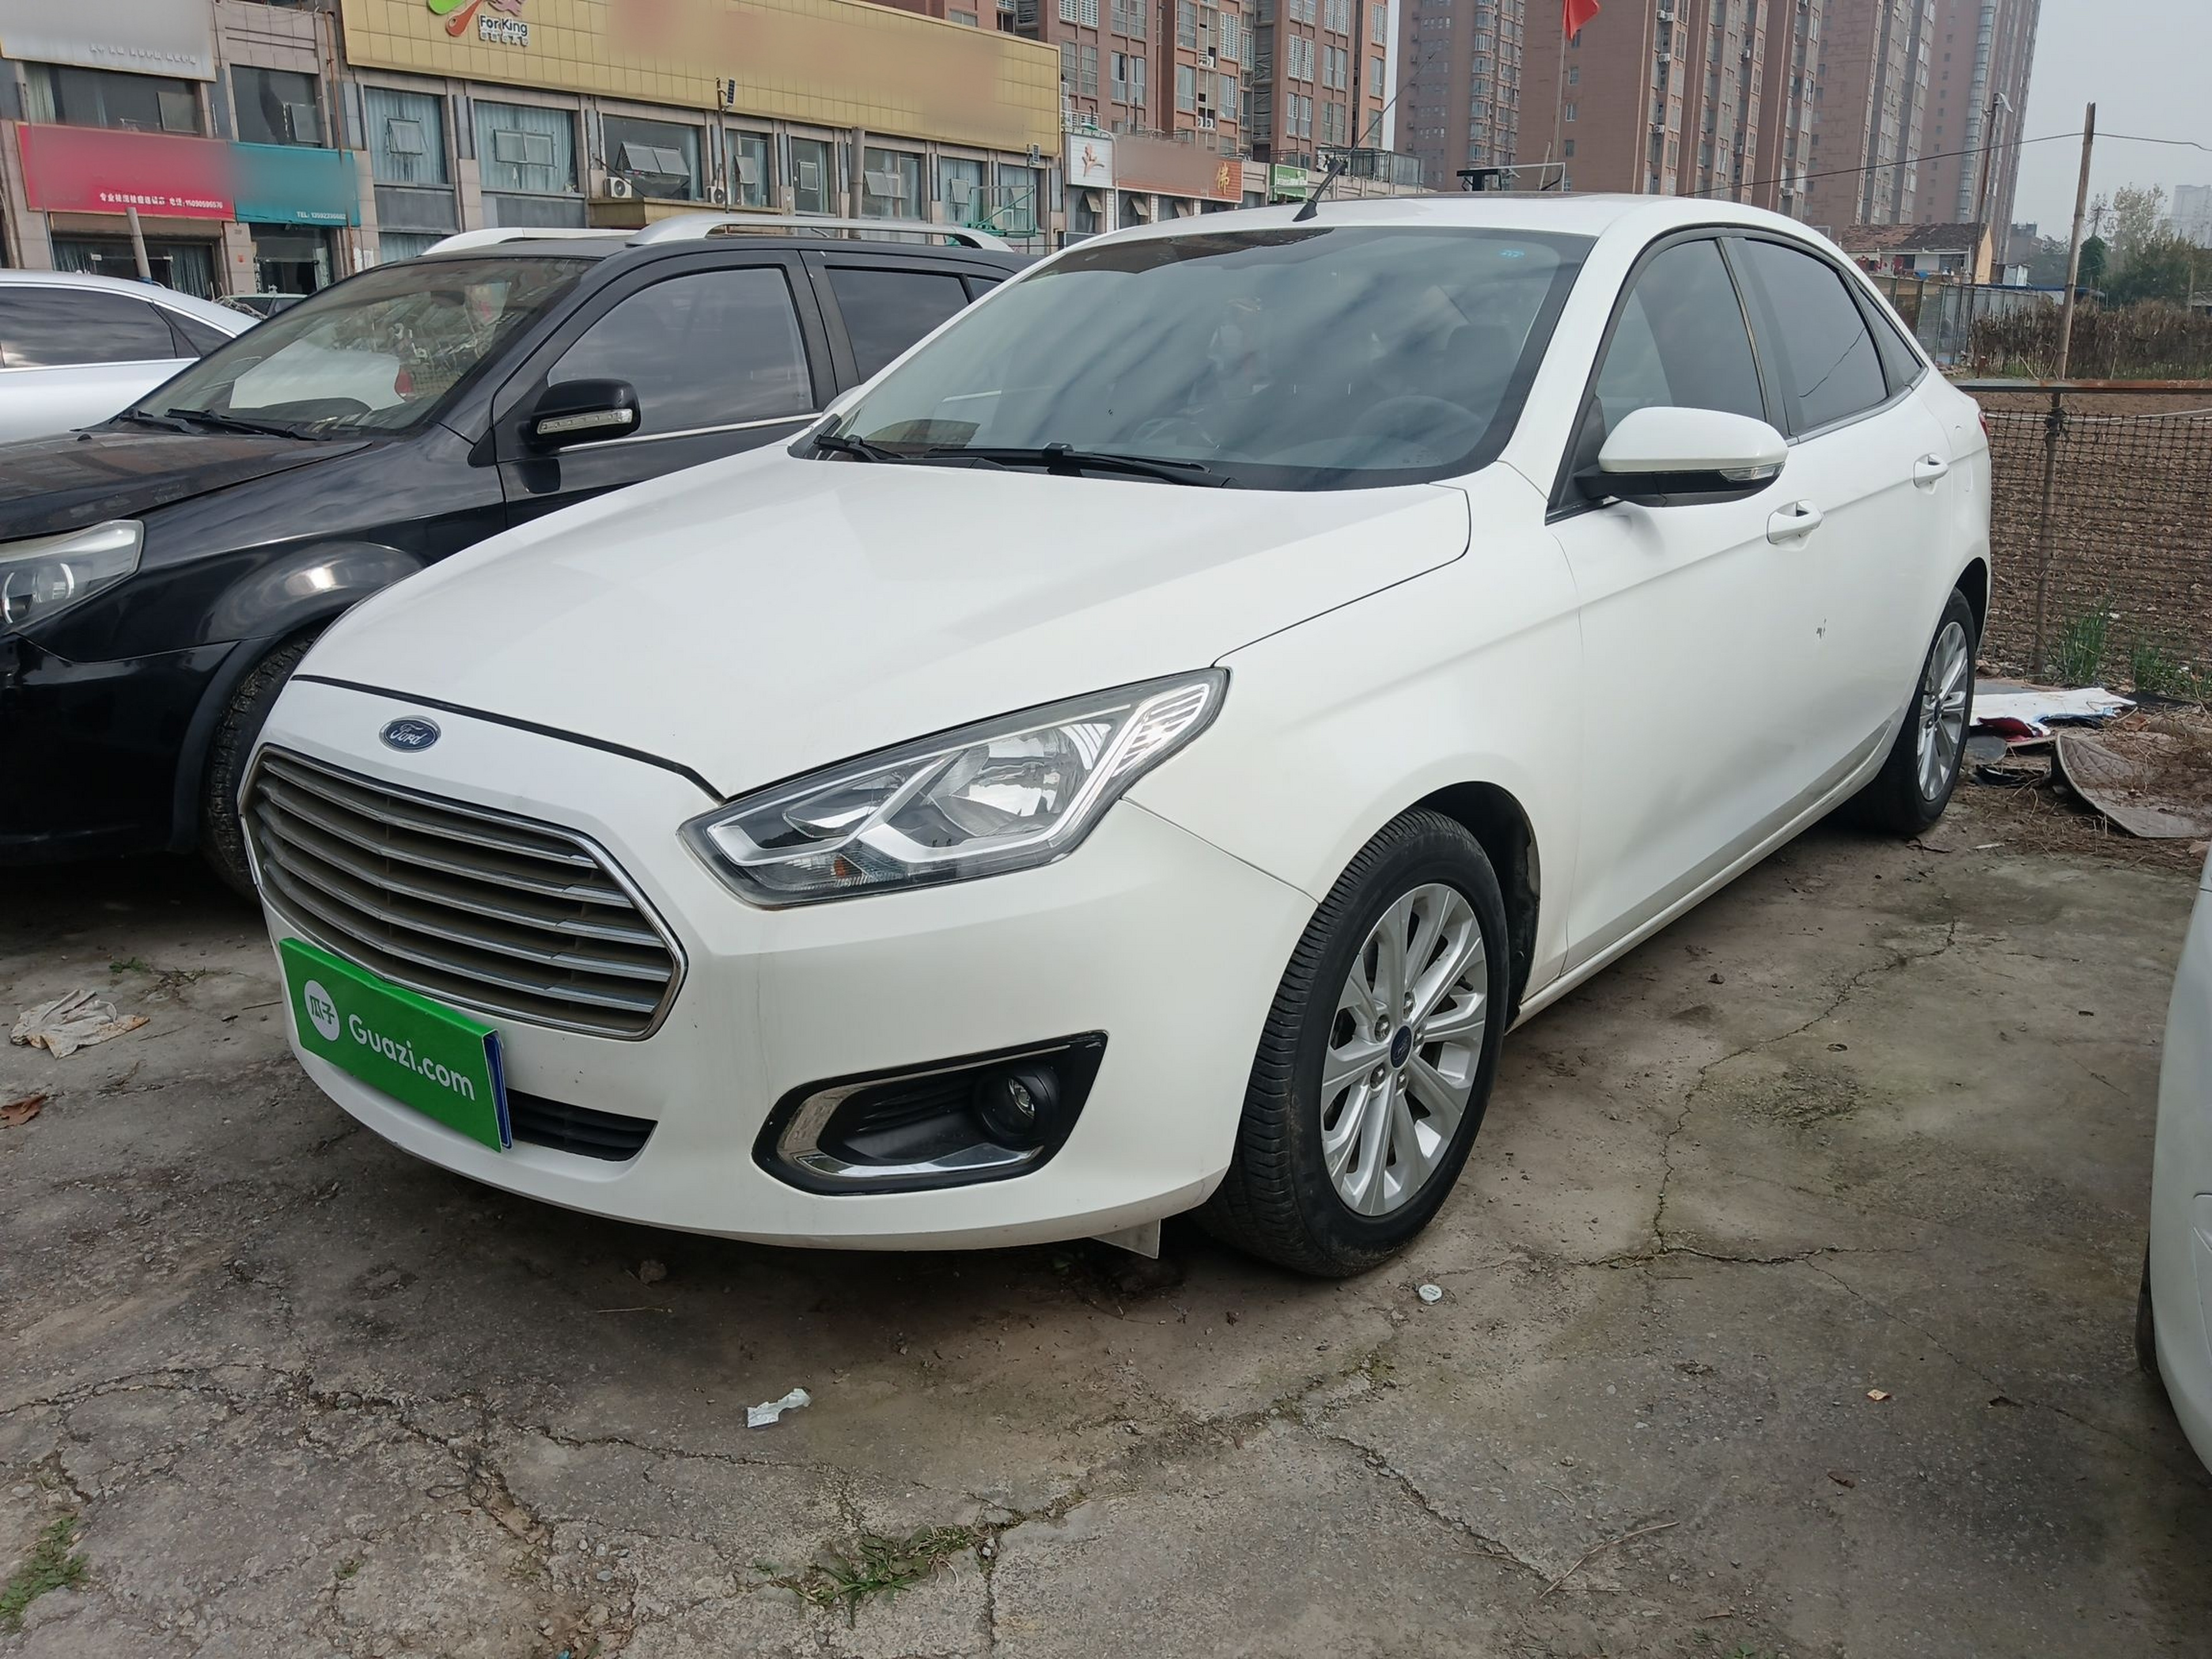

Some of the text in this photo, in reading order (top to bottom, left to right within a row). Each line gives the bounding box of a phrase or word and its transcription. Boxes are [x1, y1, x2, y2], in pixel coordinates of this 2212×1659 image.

[480, 15, 528, 36] For King
[389, 724, 428, 745] Ford
[309, 994, 335, 1025] 瓜子
[349, 1014, 476, 1101] Guazi.com
